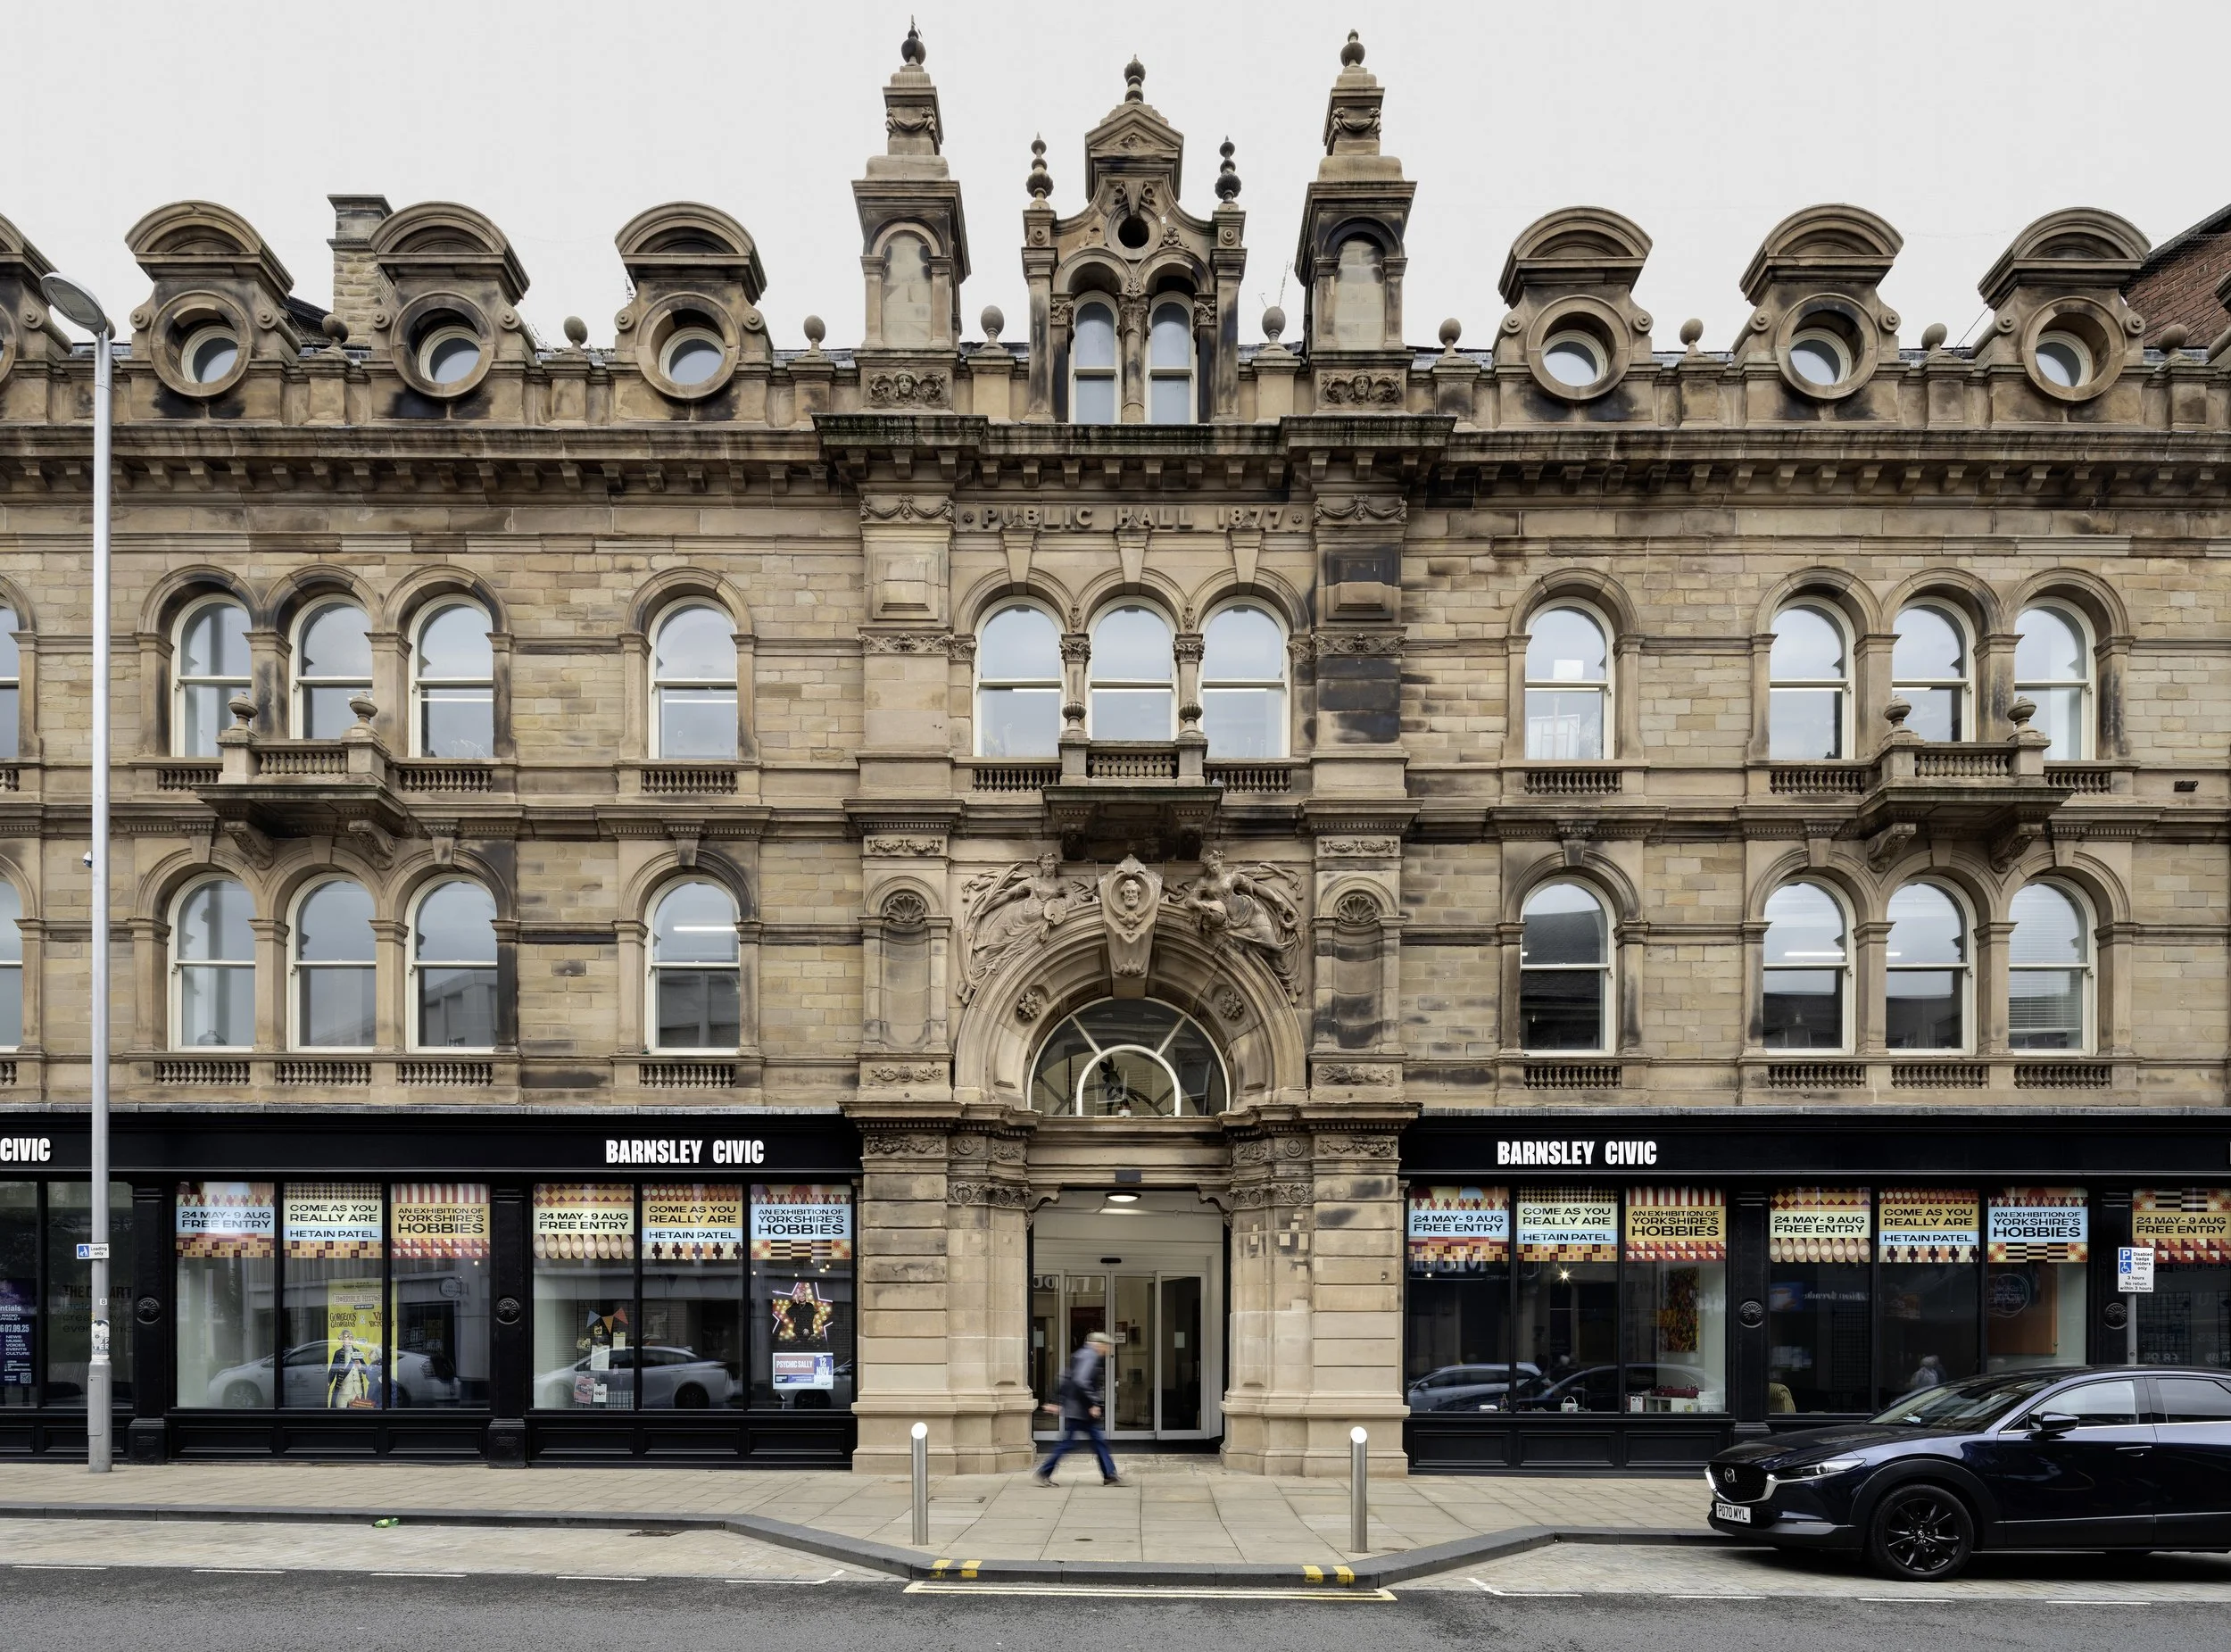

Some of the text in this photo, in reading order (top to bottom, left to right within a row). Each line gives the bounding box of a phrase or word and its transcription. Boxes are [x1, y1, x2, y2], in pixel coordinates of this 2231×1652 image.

[982, 507, 1283, 528] PUBLIC HALL 1877
[0, 1138, 50, 1161] CIVIC
[606, 1140, 764, 1164] BARNSLEY CIVIC
[1497, 1141, 1656, 1165] BARNSLEY CIVIC
[290, 1204, 328, 1212] COME
[234, 1211, 241, 1219] 9
[290, 1214, 377, 1222] REALLY ARE
[649, 1215, 736, 1223] REALLY ARE
[182, 1220, 270, 1228] FREE ENTRY
[1523, 1216, 1578, 1224] REALLY
[1774, 1216, 1789, 1224] 24
[1884, 1218, 1939, 1226] REALLY
[2136, 1216, 2152, 1224] 24
[398, 1223, 485, 1233] HOBBIES
[539, 1221, 627, 1230] FREE ENTRY
[759, 1224, 844, 1234] HOBBIES
[1414, 1224, 1503, 1232] FREE ENTRY
[1775, 1224, 1864, 1233] FREE ENTRY
[2136, 1225, 2226, 1233] FREE ENTRY
[1632, 1225, 1719, 1236] HOBBIES
[1994, 1227, 2081, 1237] HOBBIES
[5, 1324, 29, 1332] 07.09.25
[819, 1357, 826, 1366] 12
[817, 1366, 829, 1375] NOV
[1733, 1507, 1746, 1520] MYL
